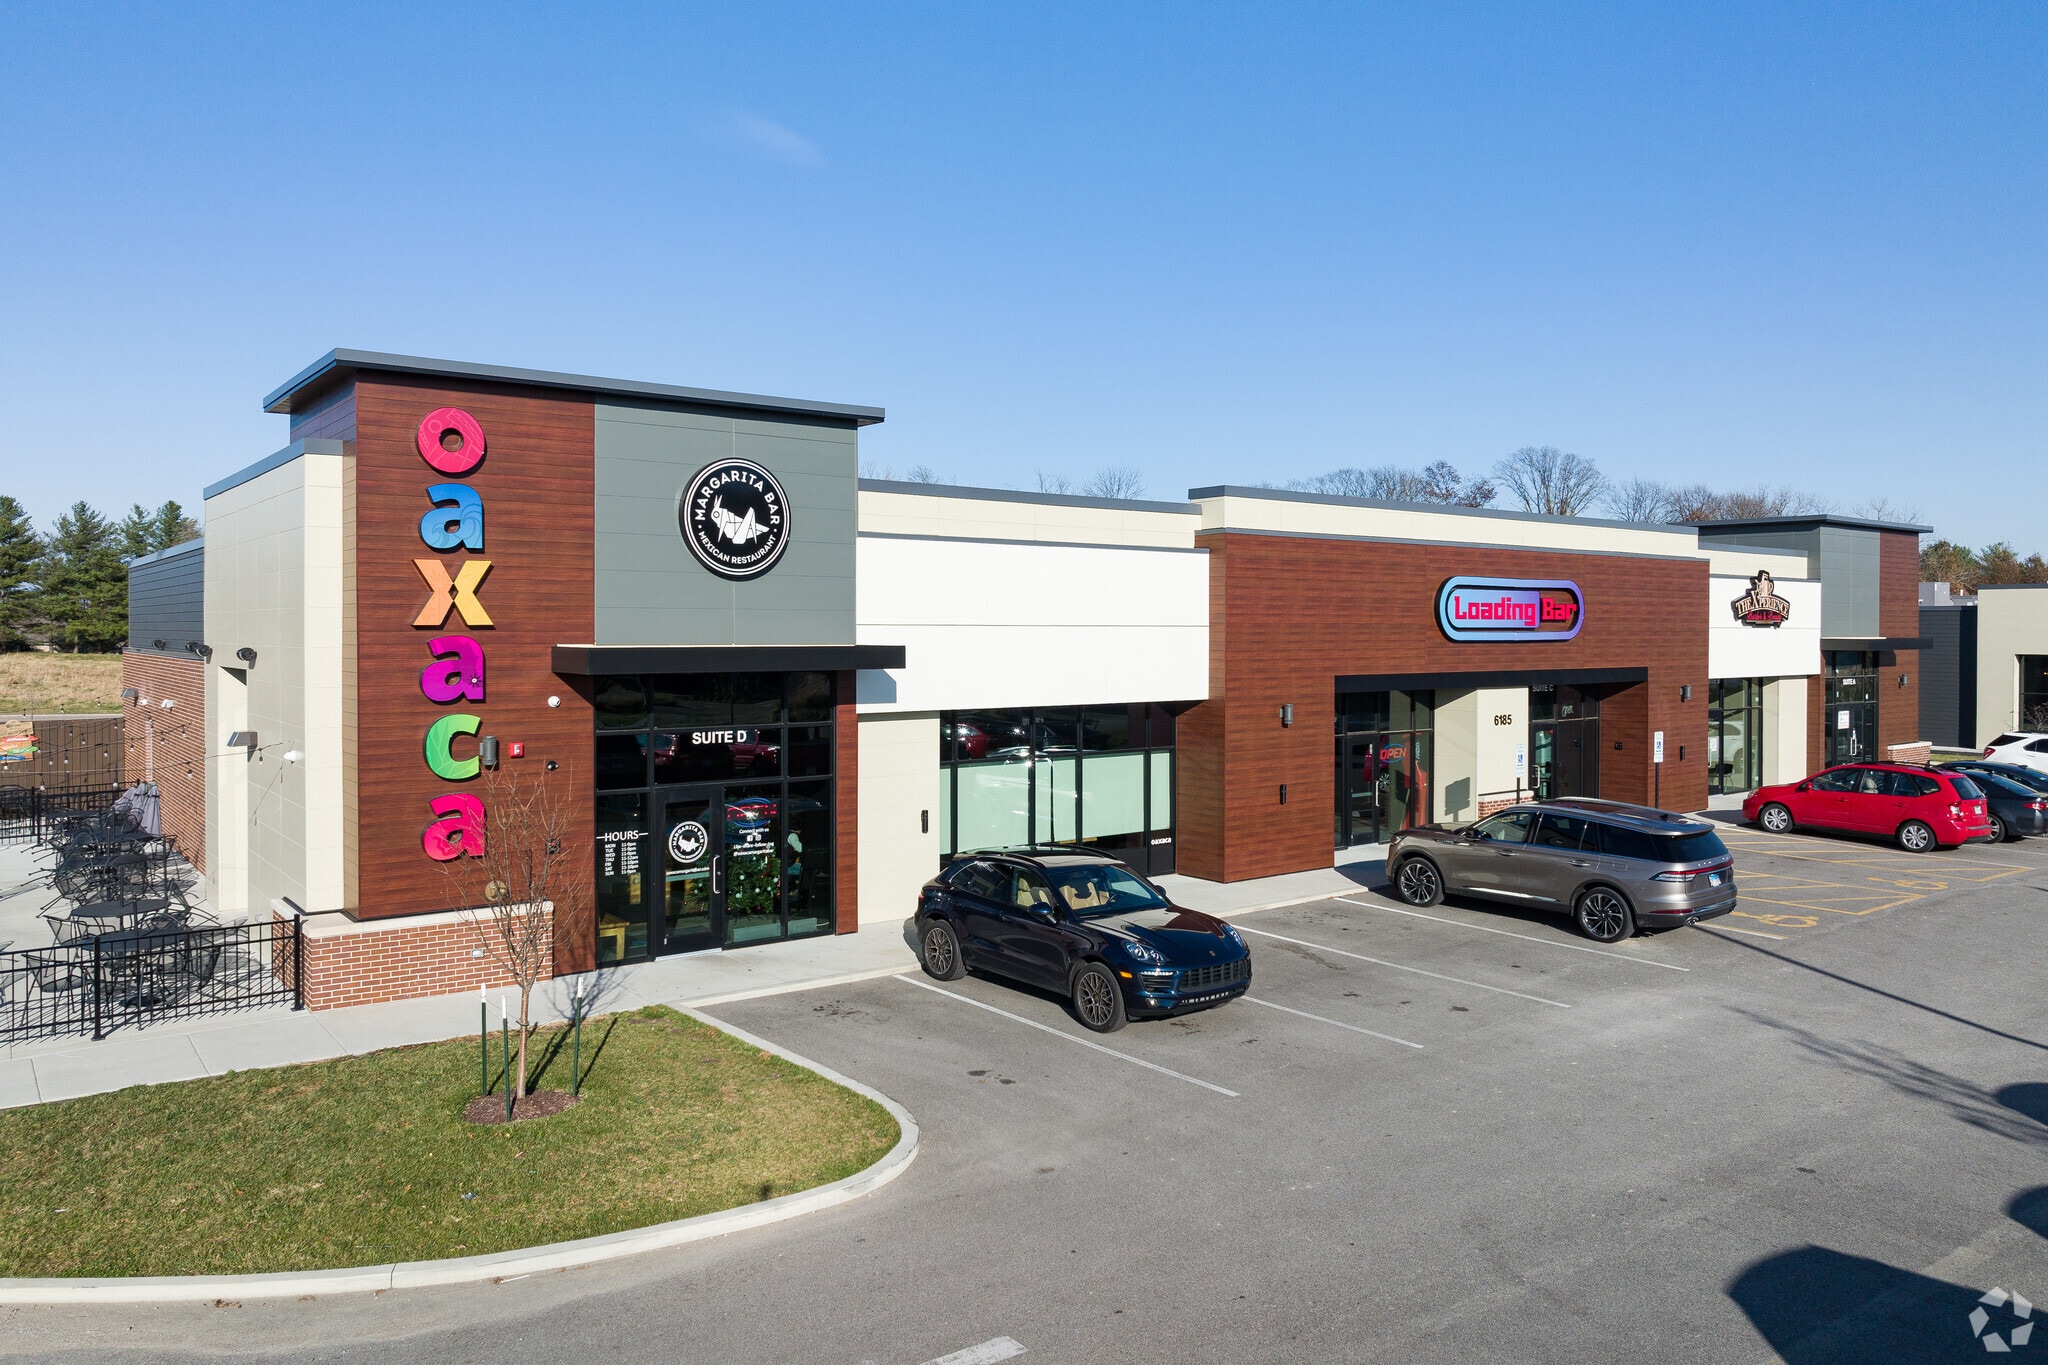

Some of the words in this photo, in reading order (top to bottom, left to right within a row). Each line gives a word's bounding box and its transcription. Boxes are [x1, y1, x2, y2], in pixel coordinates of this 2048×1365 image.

[695, 470, 764, 520] MARGARITA
[764, 492, 780, 525] BAR
[698, 531, 730, 562] MEXICAN
[731, 534, 777, 565] RESTAURANT
[1736, 598, 1752, 615] THE
[1751, 590, 1790, 616] XPERIENCE
[1454, 596, 1536, 626] Loading
[1541, 597, 1577, 621] Bar
[411, 406, 496, 861] oaxaca
[1550, 684, 1554, 692] C
[1494, 714, 1512, 726] 6185
[692, 731, 733, 745] SUITE
[737, 730, 747, 743] D
[1380, 747, 1407, 760] OPEN
[604, 830, 639, 842] HOURS
[1151, 837, 1172, 845] oaxaca
